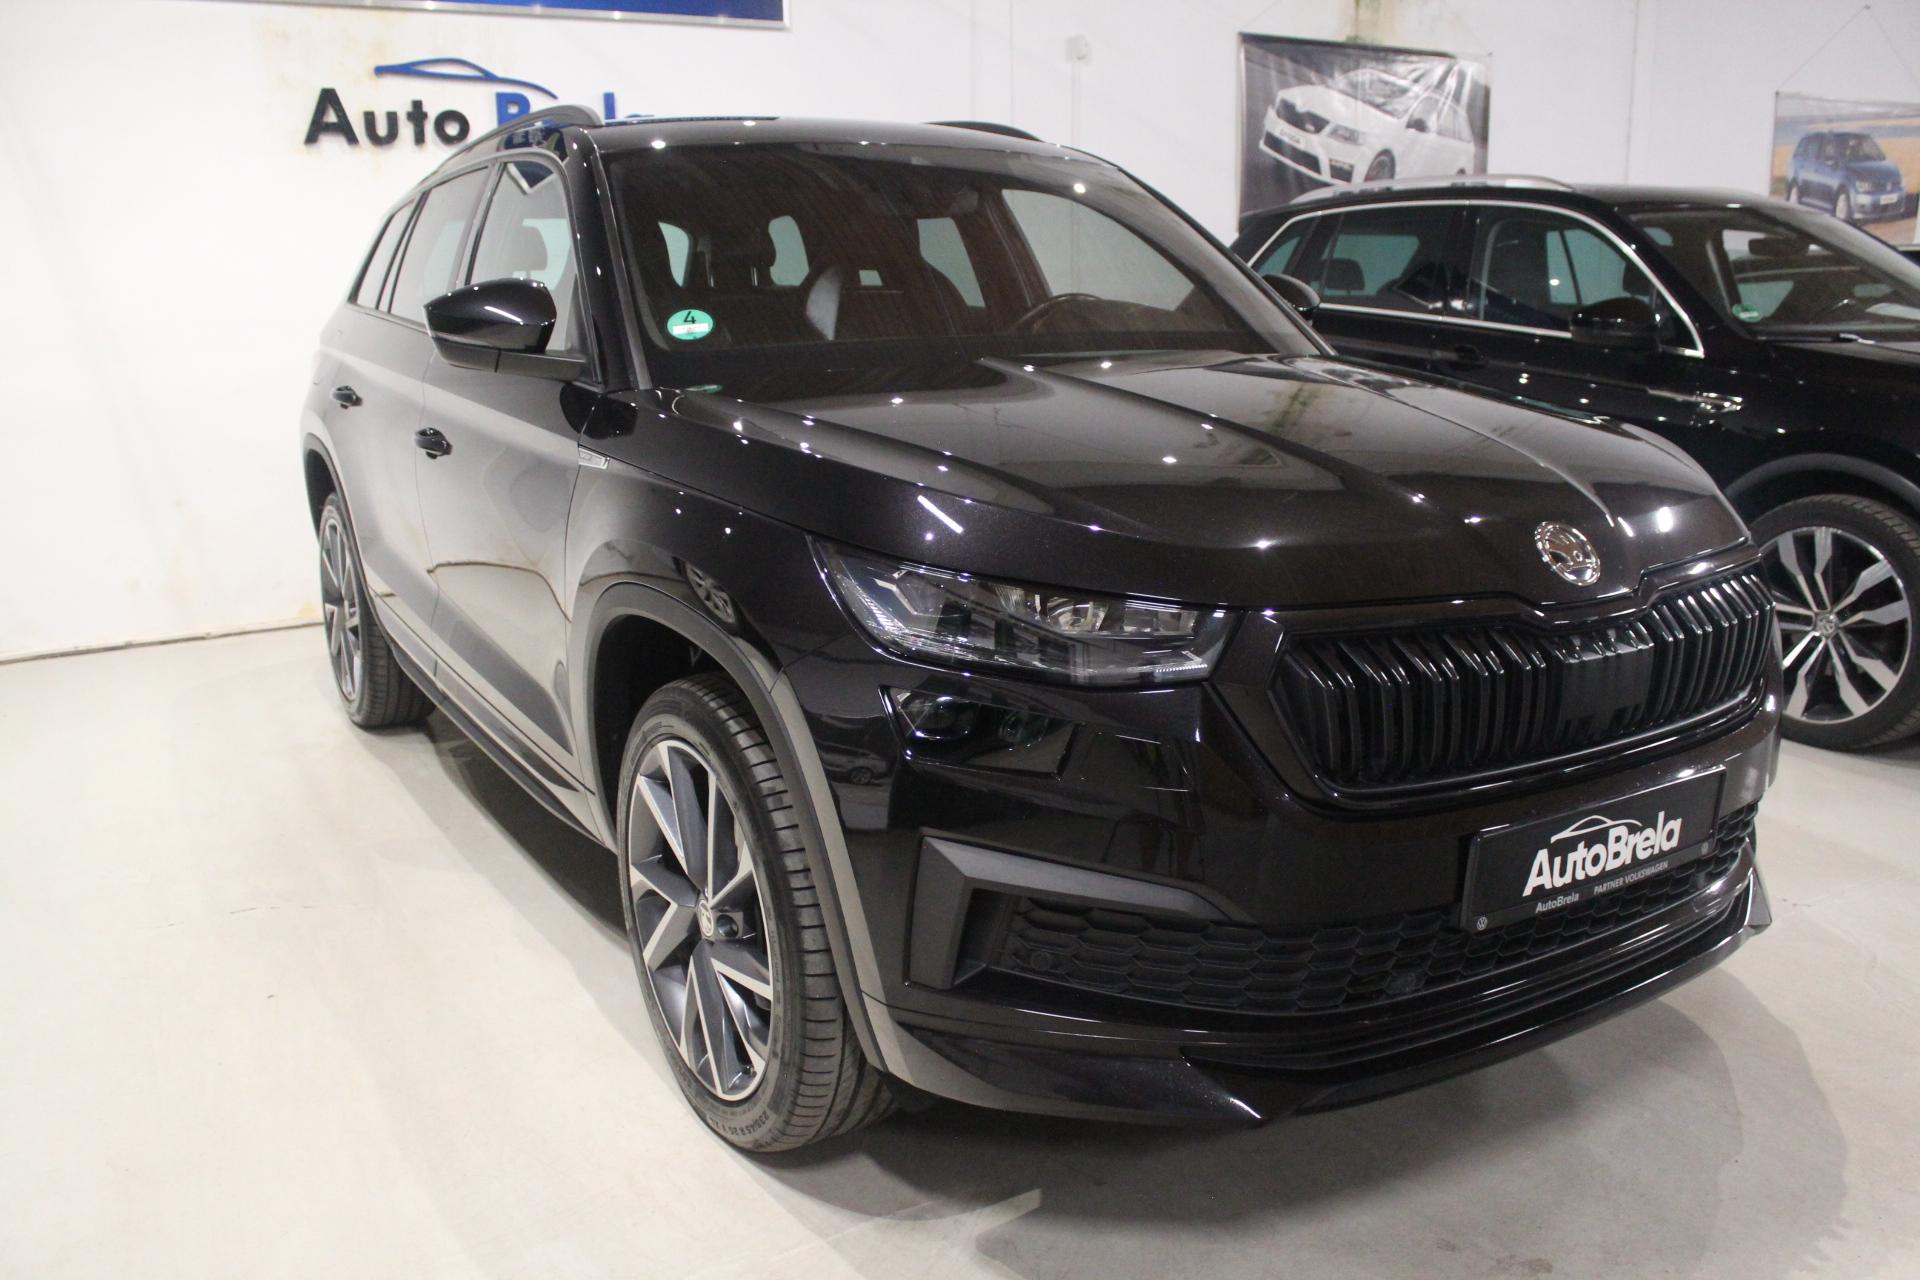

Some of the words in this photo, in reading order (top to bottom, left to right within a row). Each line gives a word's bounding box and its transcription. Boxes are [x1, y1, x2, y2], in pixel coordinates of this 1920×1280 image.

[304, 87, 470, 146] Auto
[683, 310, 697, 324] 4
[1522, 810, 1683, 897] AutoBrela
[1593, 877, 1624, 895] PARTNER
[1624, 860, 1669, 884] VOLKSWAGEN
[1535, 891, 1580, 914] AutoBrela
